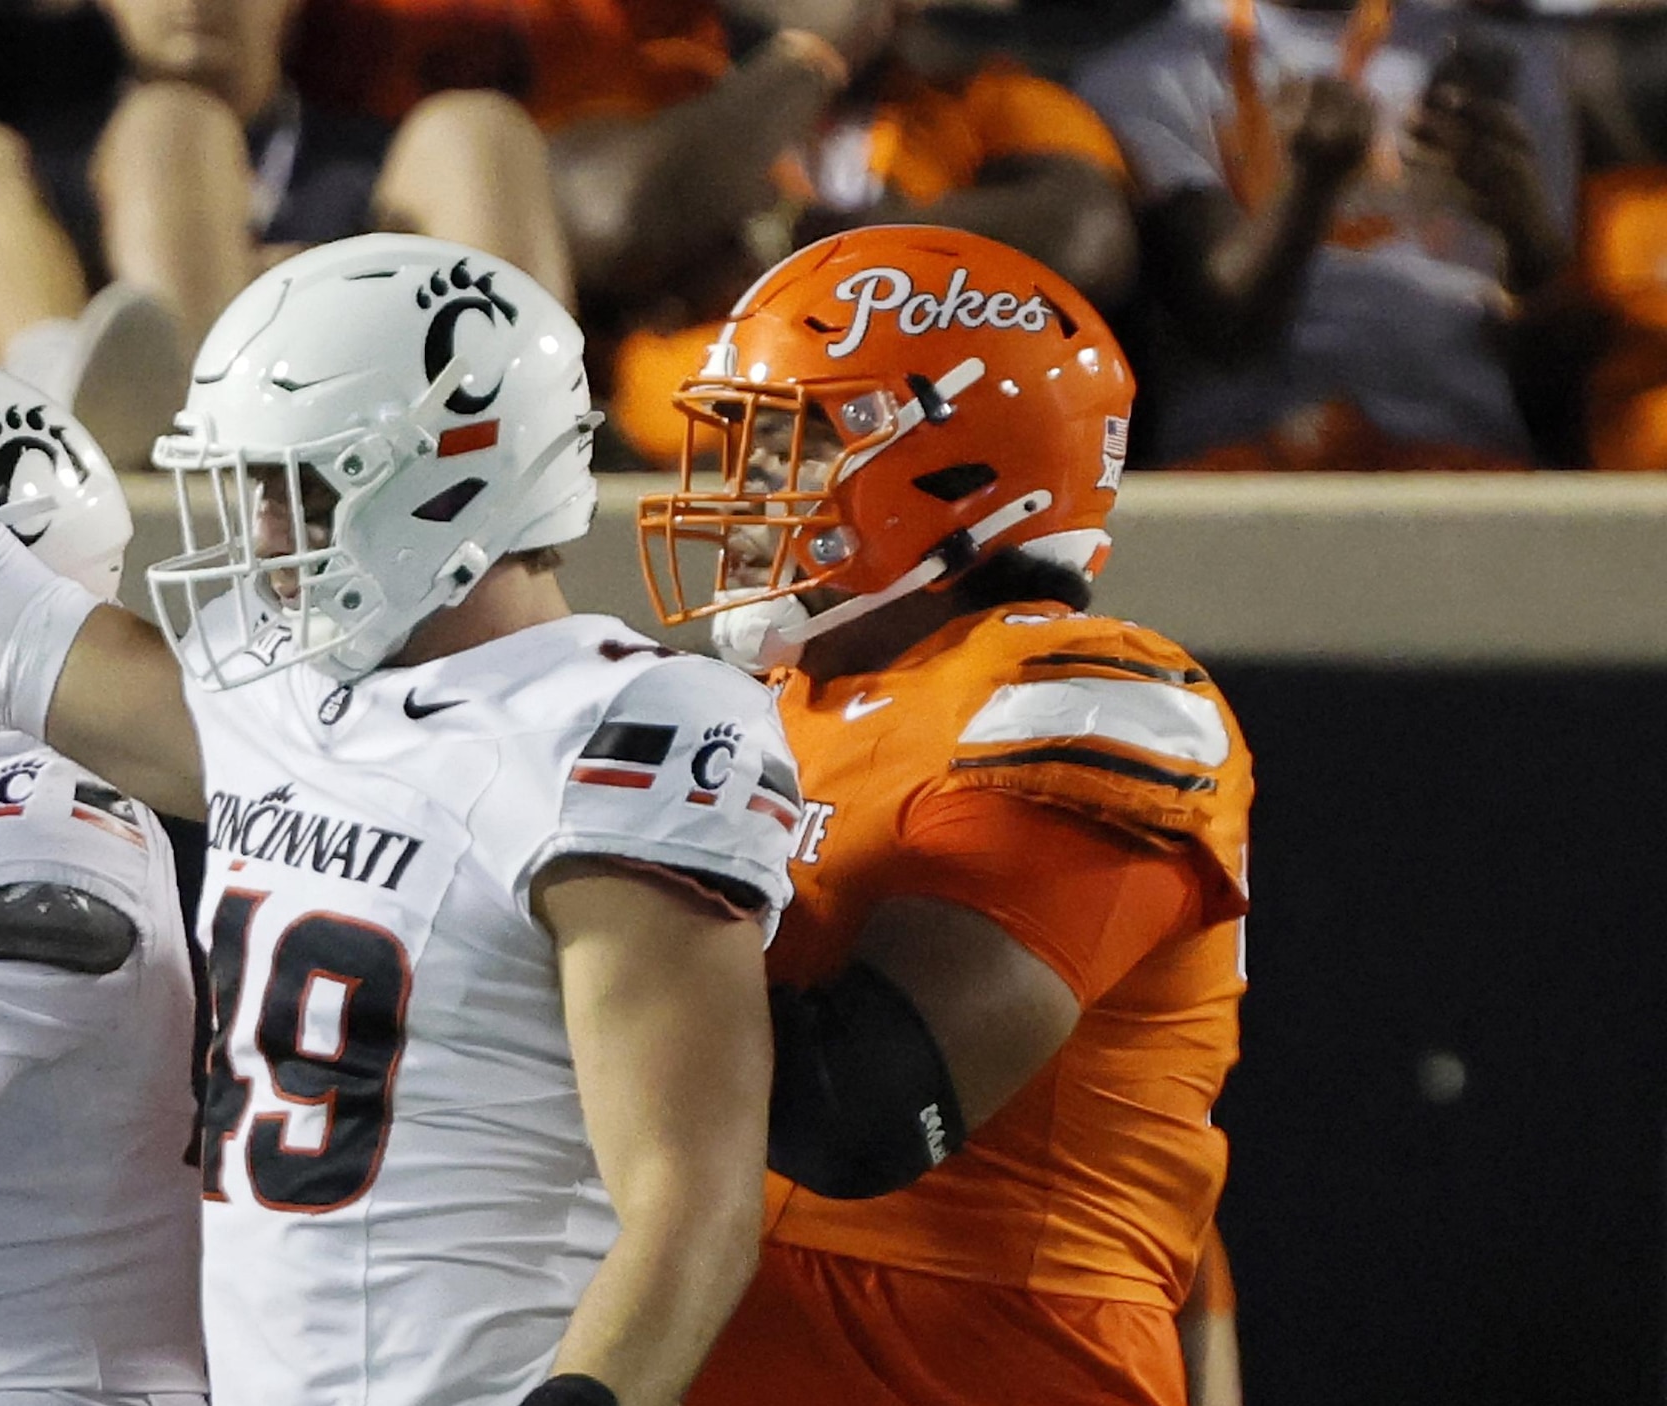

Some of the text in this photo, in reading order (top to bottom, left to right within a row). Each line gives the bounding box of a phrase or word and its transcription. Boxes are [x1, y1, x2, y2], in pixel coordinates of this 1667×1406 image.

[826, 266, 1054, 358] Pokes
[207, 785, 425, 891] CINCINNATI
[200, 887, 413, 1214] 49
